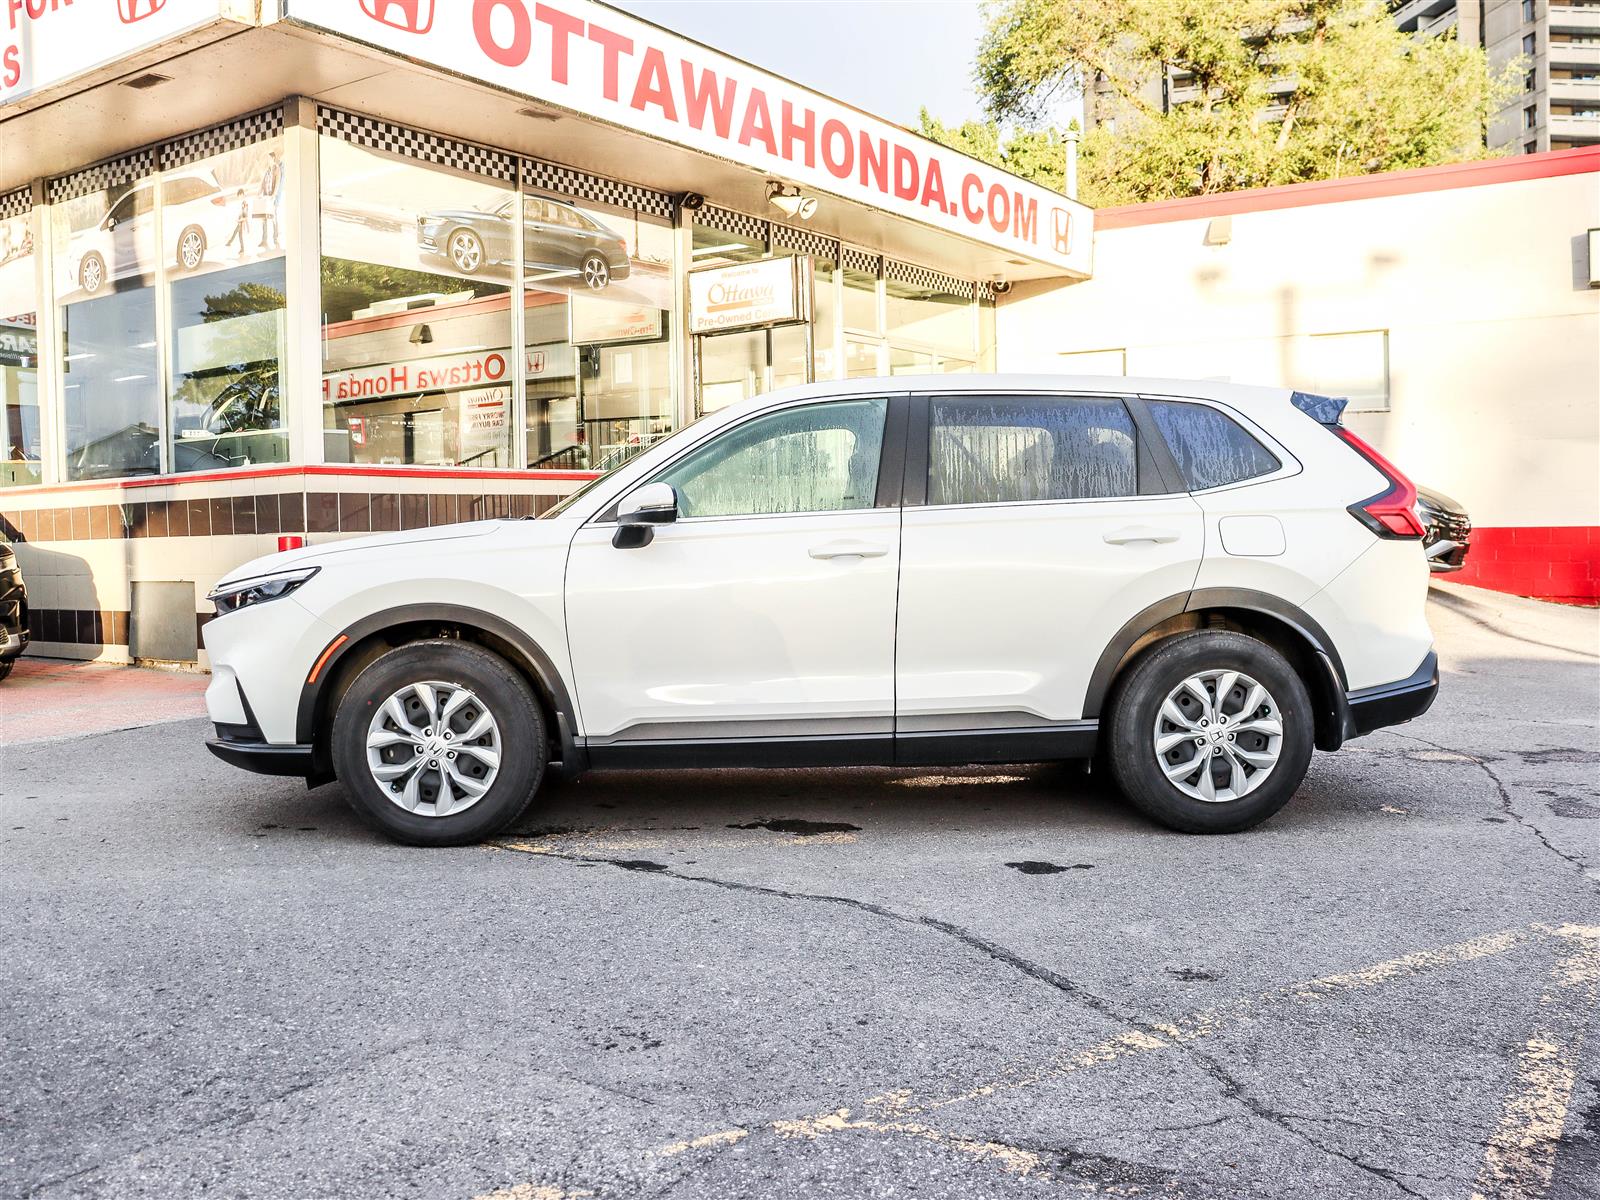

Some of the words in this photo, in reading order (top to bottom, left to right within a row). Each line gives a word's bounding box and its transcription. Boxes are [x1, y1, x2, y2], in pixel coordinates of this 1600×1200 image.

[471, 0, 1039, 247] OTTAWAHONDA.COM
[707, 283, 775, 305] Ottawa
[697, 311, 752, 328] Pre-Owned
